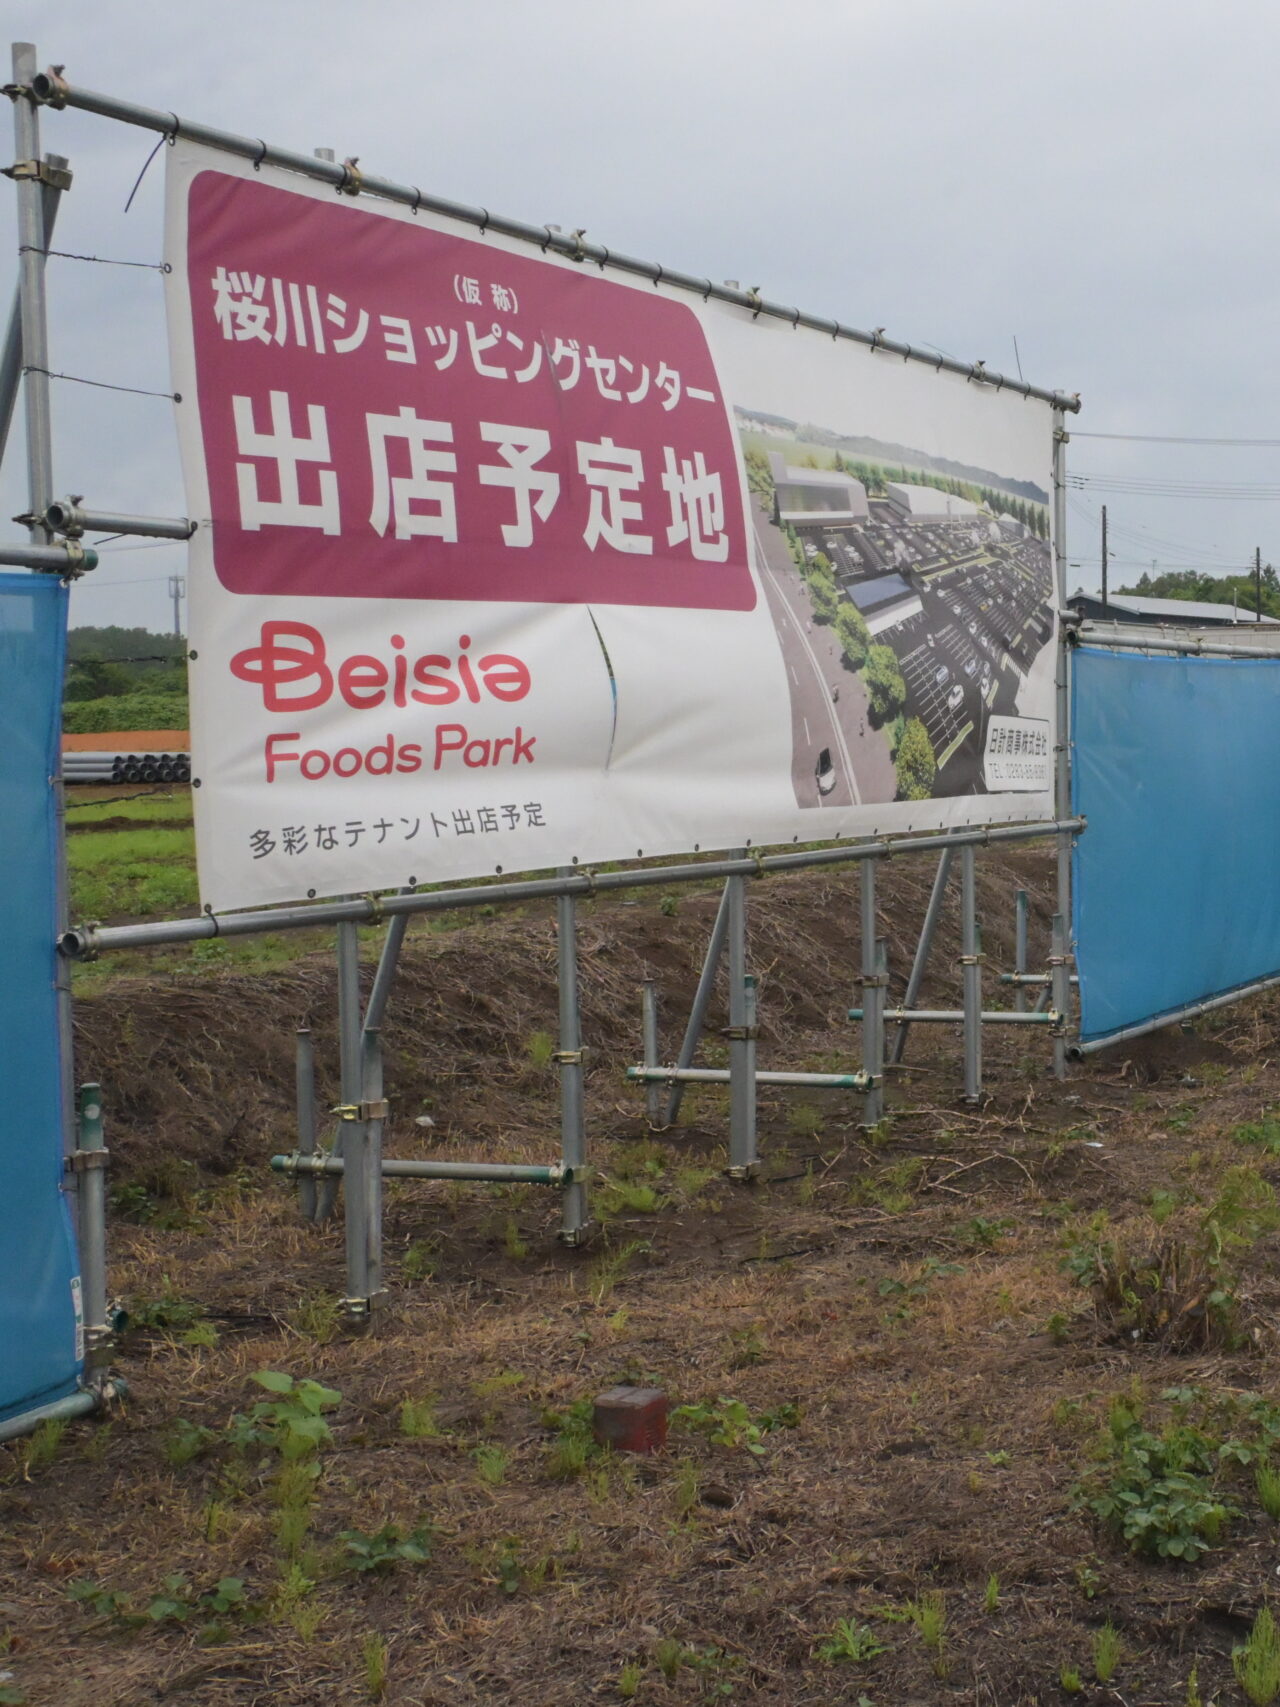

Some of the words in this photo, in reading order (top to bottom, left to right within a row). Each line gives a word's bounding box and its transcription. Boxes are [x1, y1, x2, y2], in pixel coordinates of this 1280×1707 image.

[453, 274, 519, 315] (仮称)
[211, 266, 716, 412] 桜川ショッピングセンター
[231, 390, 730, 563] 出店予定地
[265, 732, 422, 783] Foods
[434, 723, 537, 770] Park
[249, 801, 547, 860] 多彩なテナント出店予定
